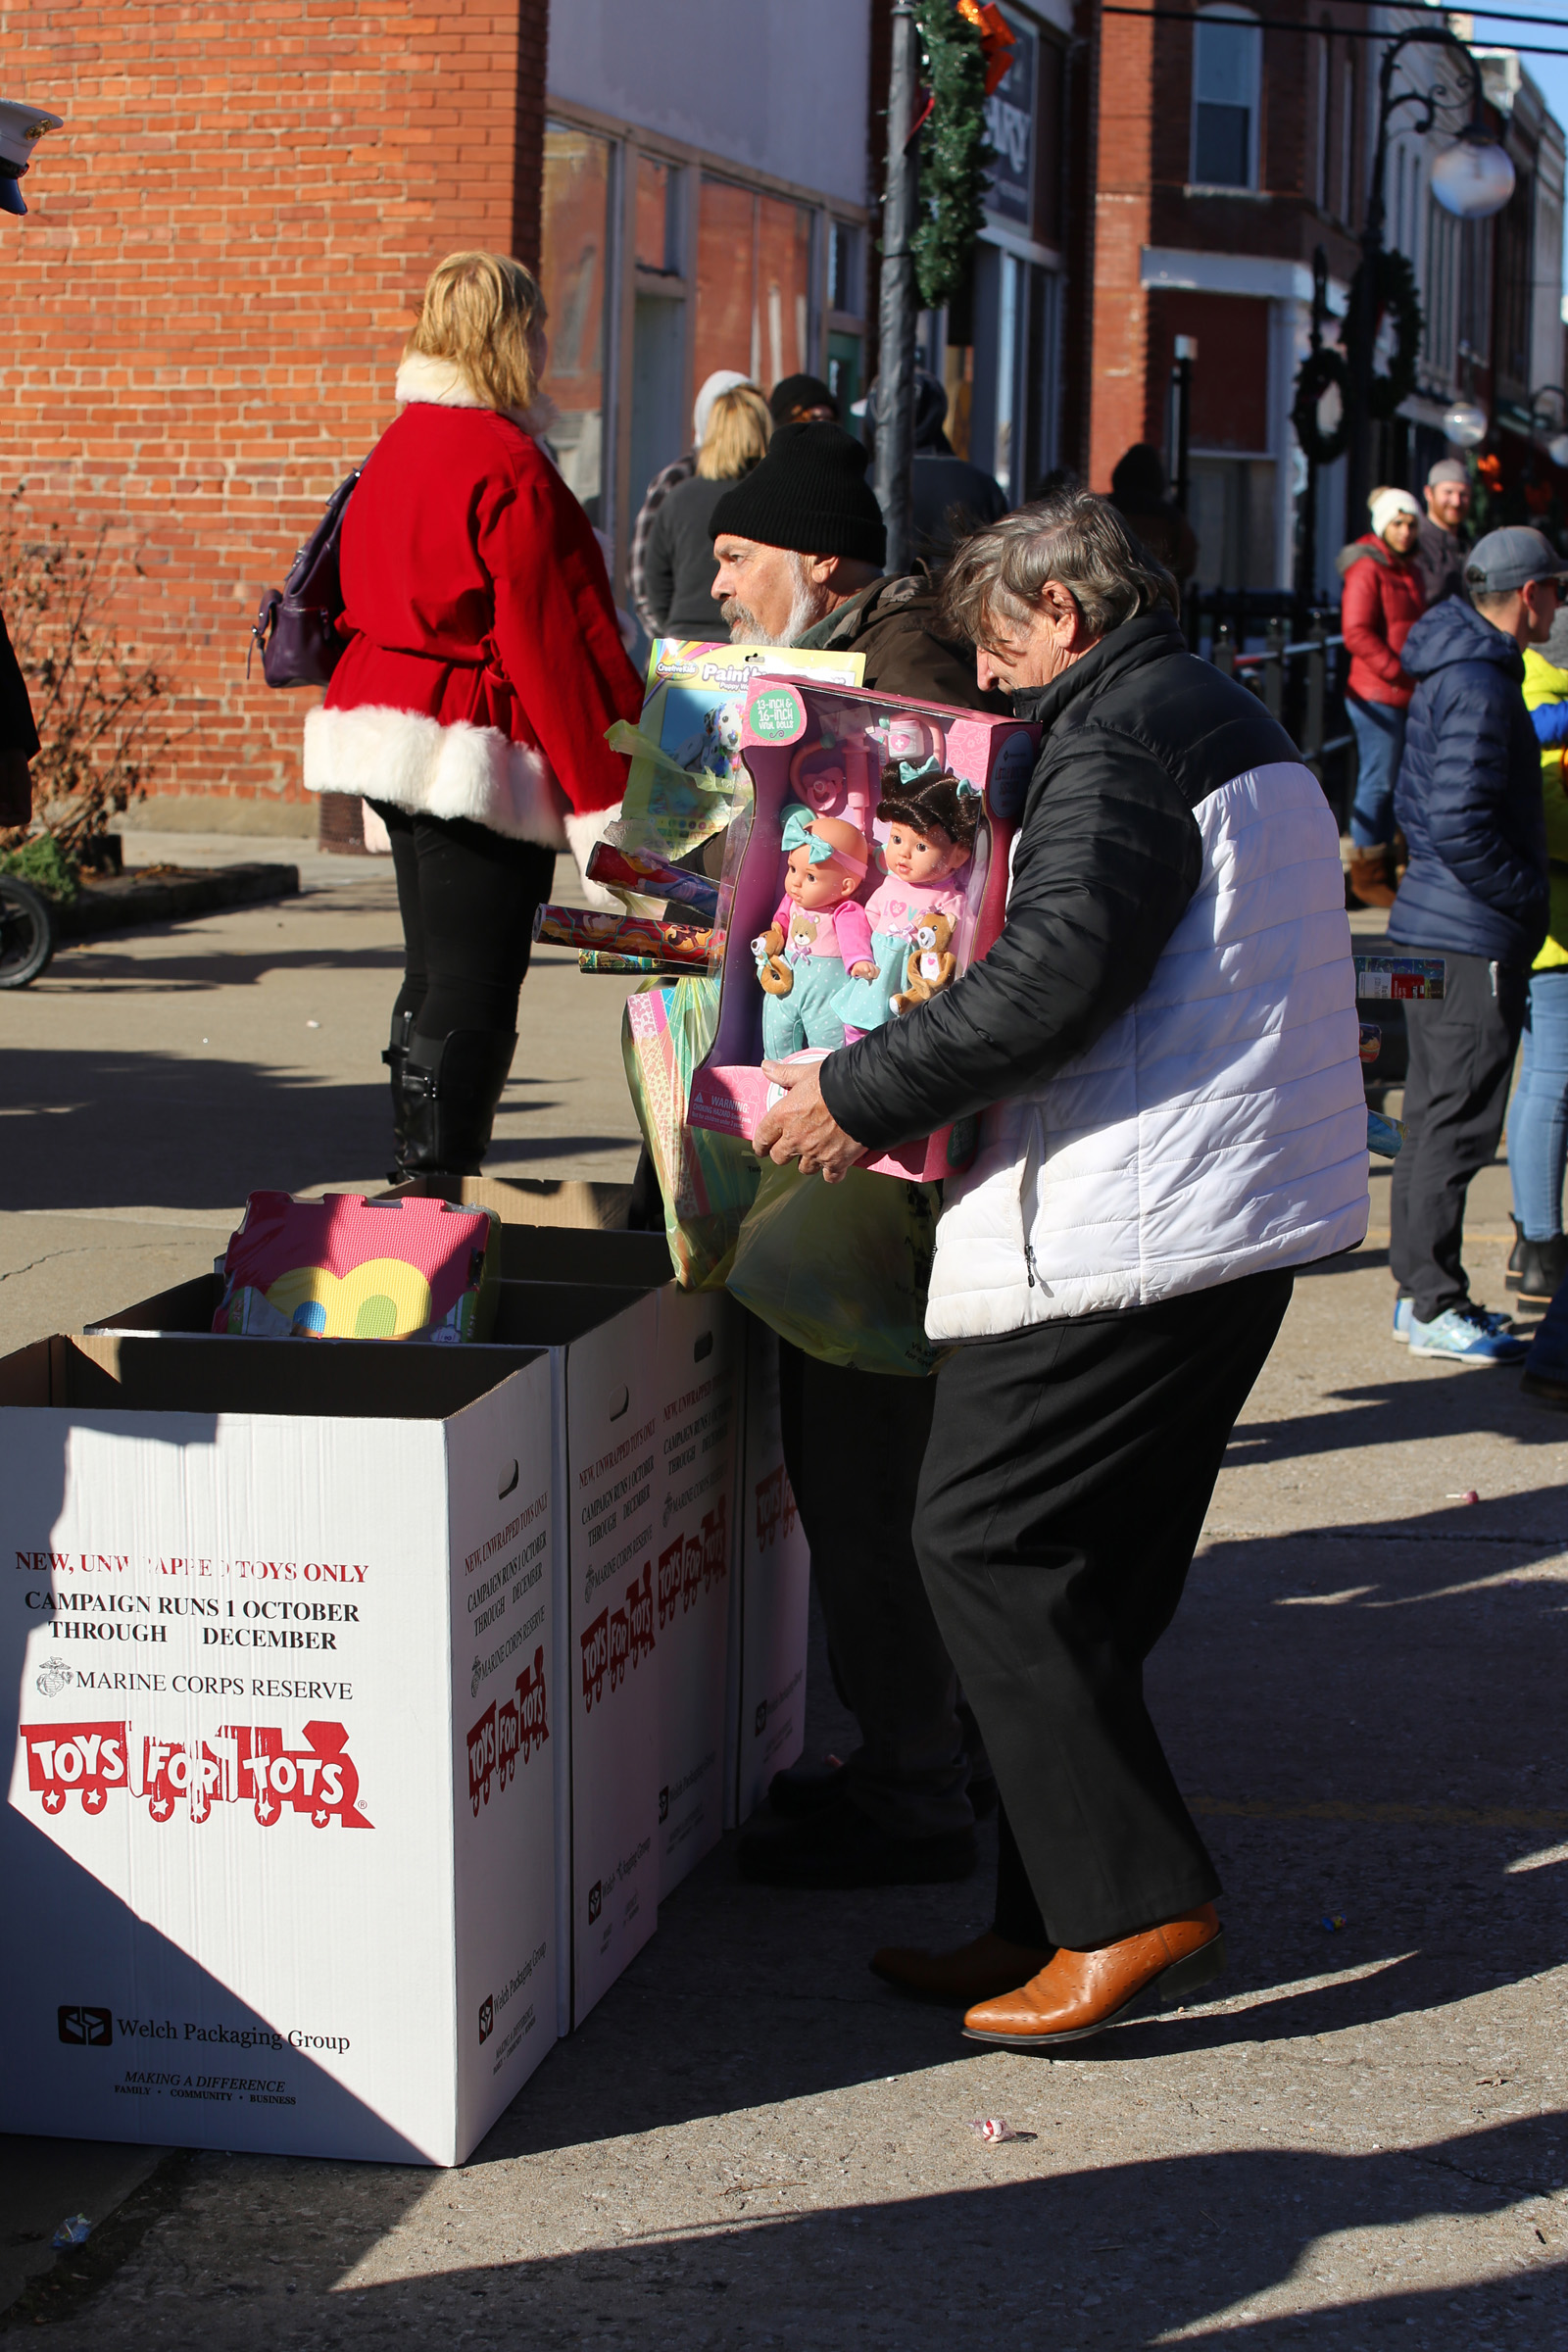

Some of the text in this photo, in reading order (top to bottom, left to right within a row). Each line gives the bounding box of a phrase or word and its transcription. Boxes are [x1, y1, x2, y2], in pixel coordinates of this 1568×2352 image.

[703, 663, 751, 683] Paint
[785, 698, 793, 709] &
[776, 719, 794, 729] DOLLS
[693, 1102, 712, 1114] CHOKING
[711, 1095, 751, 1114] WARNING:
[663, 1422, 694, 1455] CAMPAIGN
[579, 1463, 595, 1491] NEW,
[595, 1438, 630, 1478] UNWRAPPED
[630, 1427, 643, 1454] TOYS
[668, 1445, 696, 1476] THROUGH
[581, 1488, 613, 1526] CAMPAIGN
[613, 1476, 628, 1502] RUNS
[632, 1454, 655, 1486] OCTOBER
[588, 1483, 651, 1547] THROUGH DECEMBER
[465, 1491, 548, 1577] NEW, UNWRAPPED TOYS ONLY
[16, 1551, 369, 1583] NEW, UNWAPPE TOYS ONLY
[467, 1571, 502, 1614] CAMPAIGN
[502, 1556, 518, 1587] RUNS
[522, 1530, 547, 1566] OCTOBER
[595, 1523, 653, 1589] MARINE CORPS RESERVE
[660, 1551, 682, 1600] TOYS
[686, 1547, 701, 1581] FOR
[24, 1591, 360, 1623] CAMPAIGN RUNS 1 OCTOBER
[474, 1561, 543, 1638] THROUGH DECEMBER
[48, 1620, 338, 1650] THROUGH DECEMBER
[481, 1604, 545, 1681] MARINE CORPS RESERVE
[583, 1596, 651, 1682] TOYS FOR TOTS
[75, 1670, 354, 1700] MARINE CORPS RESERVE
[469, 1684, 543, 1783] TOYS FOR TOTS
[30, 1734, 344, 1805] TOYS FOR TOTS
[494, 1941, 547, 2015] Welch Packaging Group
[117, 2018, 351, 2055] Welch Packaging Group
[114, 2083, 297, 2105] FAMILY COMMUNITY BUSINESS
[124, 2071, 286, 2093] MAKING A DIFFERENCE
